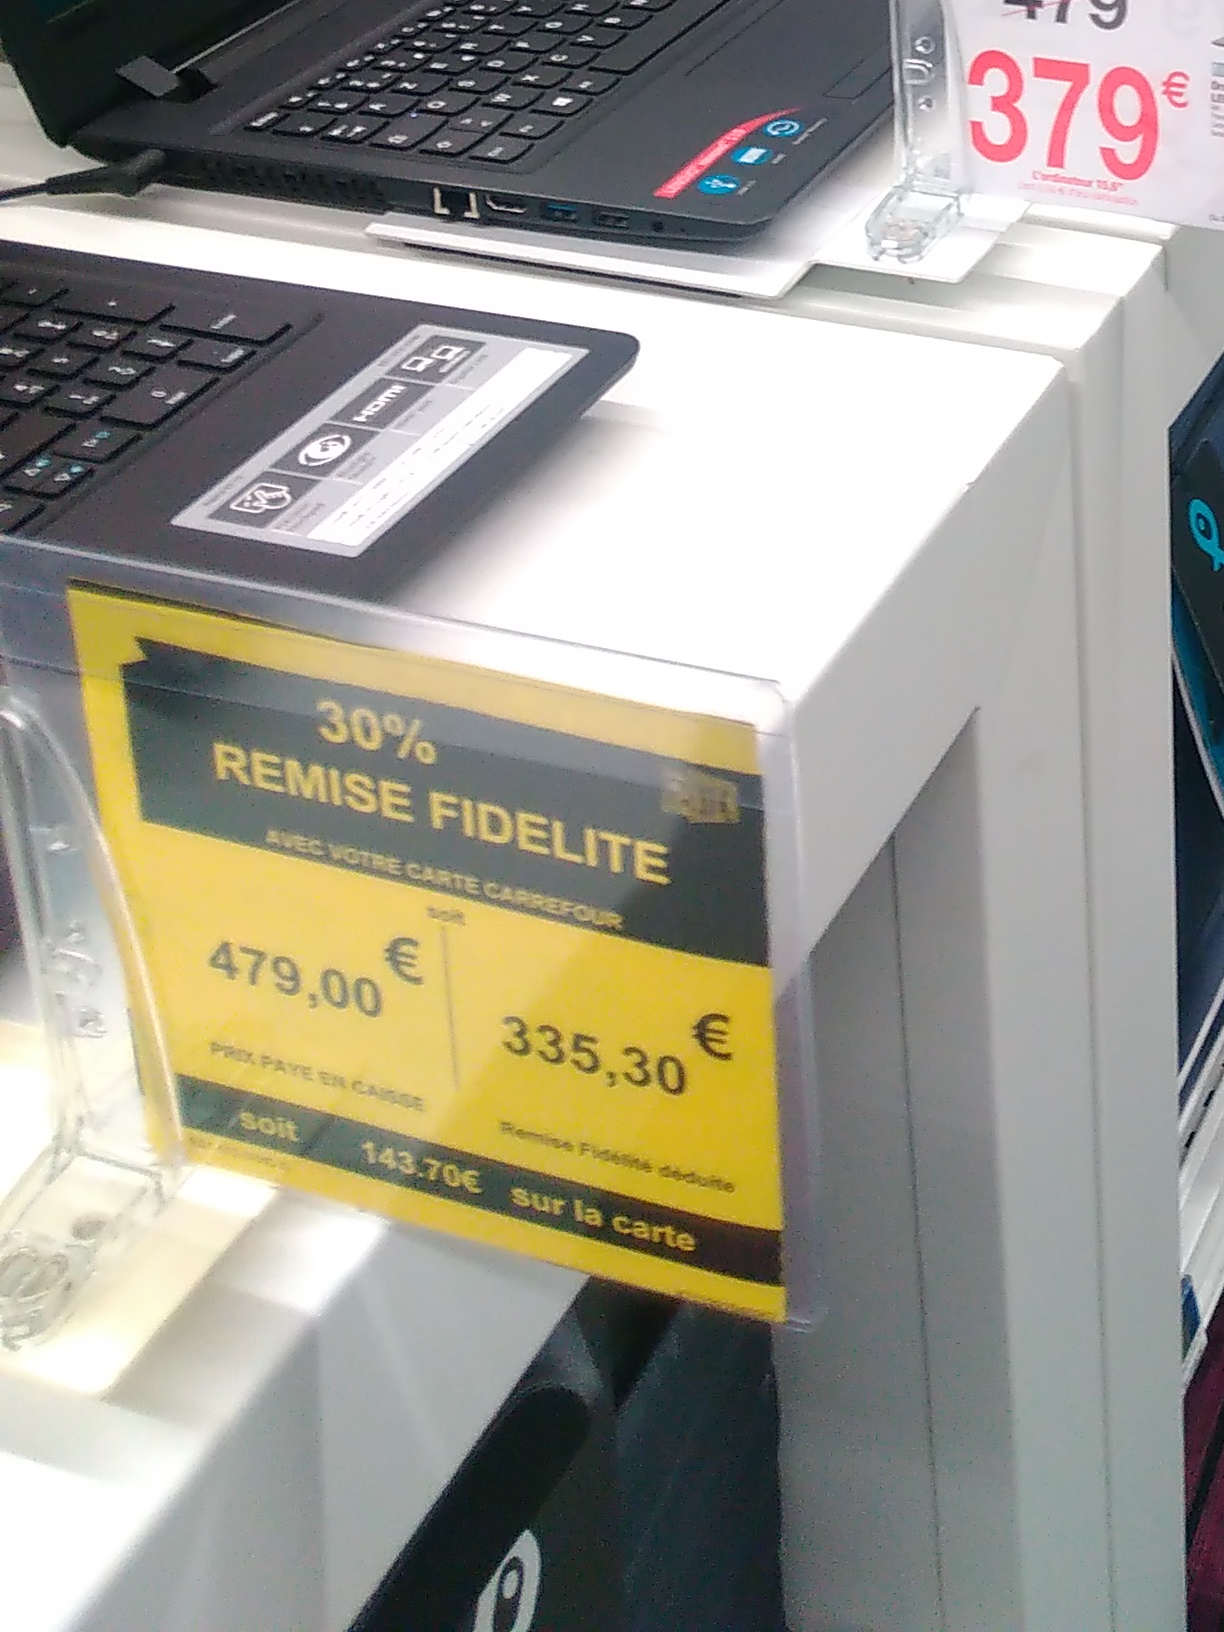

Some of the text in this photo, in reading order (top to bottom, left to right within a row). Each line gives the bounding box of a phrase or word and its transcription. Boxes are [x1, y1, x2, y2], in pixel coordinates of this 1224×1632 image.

[967, 49, 1192, 182] 379€
[316, 698, 439, 766] 30%
[212, 741, 416, 824] REMISE
[427, 790, 673, 887] FIDELITE
[265, 829, 624, 931] AVEC VOTRE CARTE CARREFOUR
[508, 1186, 567, 1216] sur
[572, 1196, 605, 1228] la
[611, 1212, 698, 1253] carte
